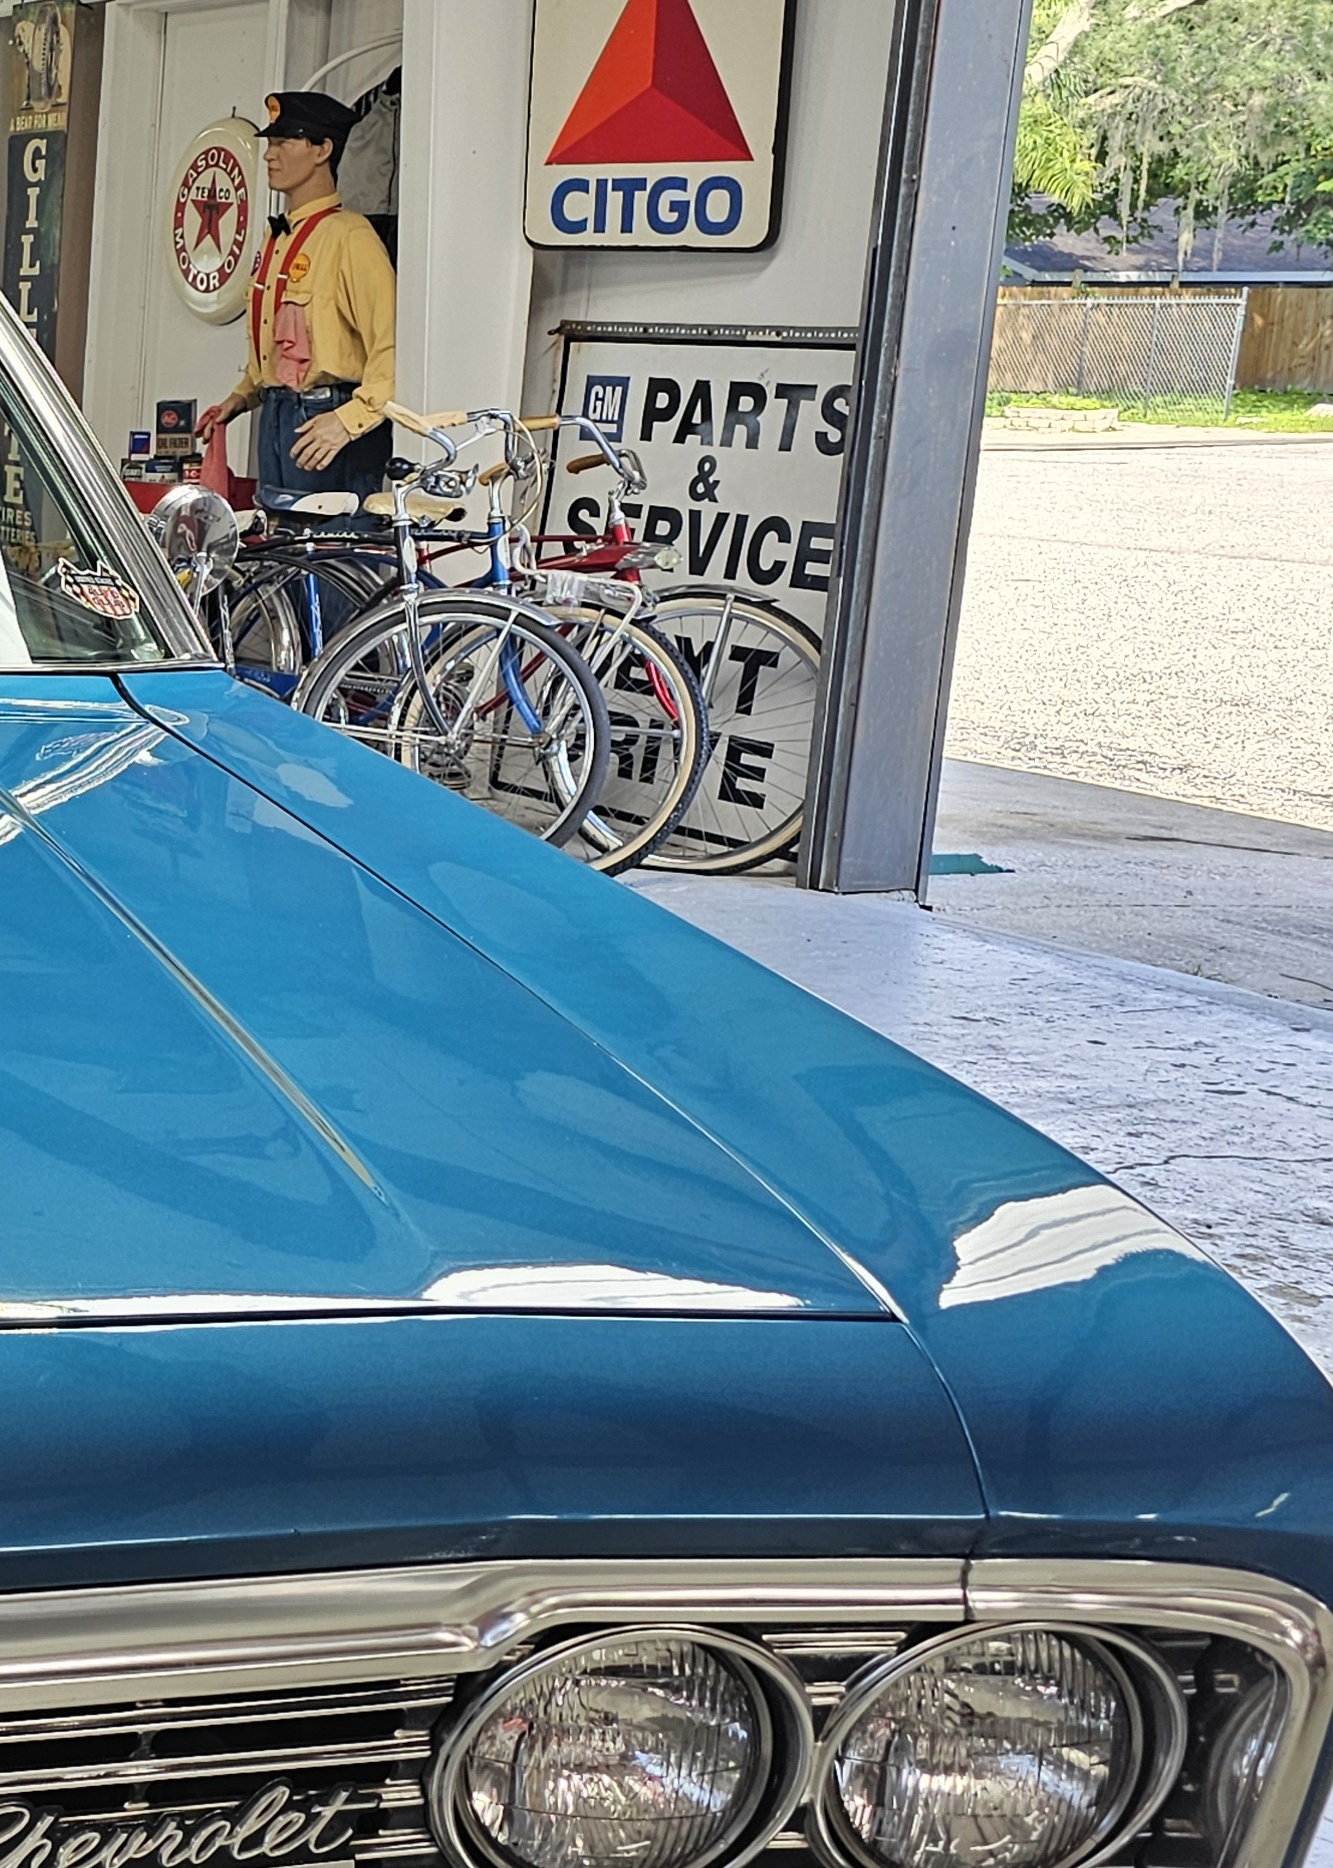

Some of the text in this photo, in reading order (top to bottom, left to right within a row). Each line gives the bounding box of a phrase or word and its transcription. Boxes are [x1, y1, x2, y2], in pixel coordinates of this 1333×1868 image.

[179, 149, 247, 205] GASOLINE
[550, 175, 744, 236] CITGO
[174, 227, 246, 291] MOTOR OIL
[589, 384, 623, 422] GM
[639, 376, 852, 456] PARTS
[688, 454, 721, 503] &
[570, 710, 776, 810] RIE
